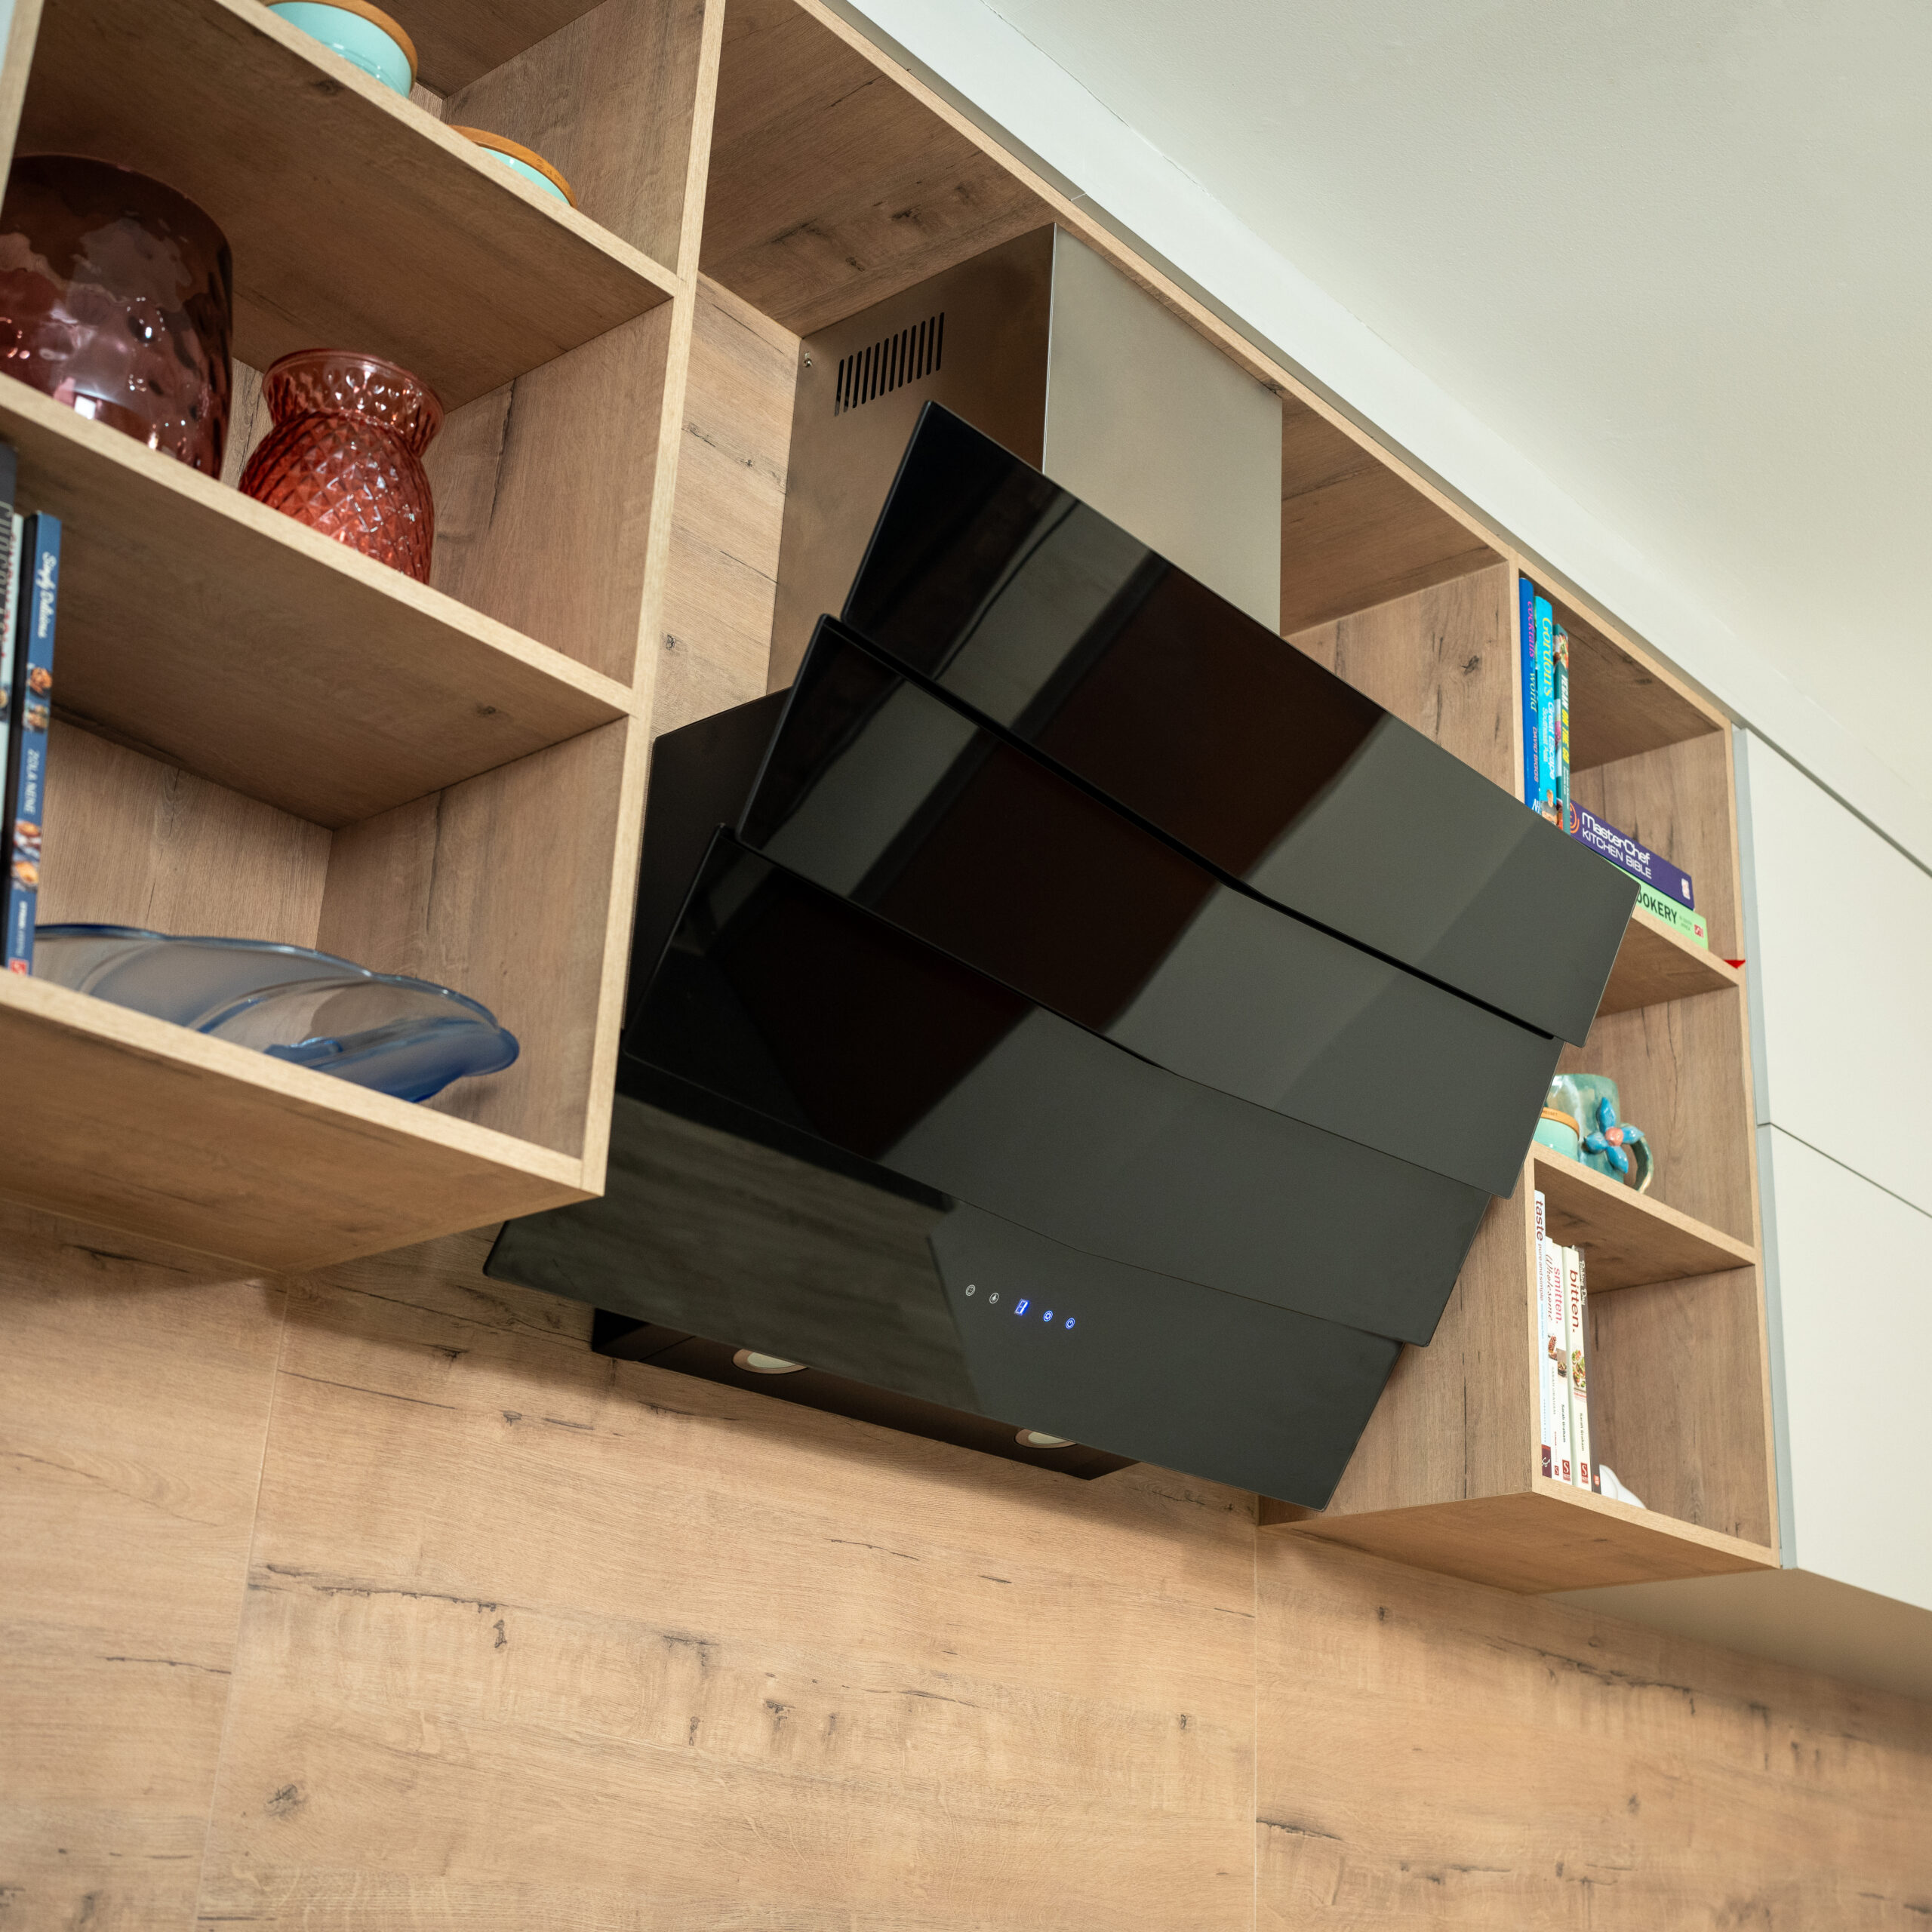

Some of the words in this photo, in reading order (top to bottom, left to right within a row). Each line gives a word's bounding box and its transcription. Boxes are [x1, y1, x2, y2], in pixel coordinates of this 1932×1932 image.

[1527, 601, 1535, 659] cocktails
[1542, 617, 1553, 697] Gordon's
[1561, 709, 1569, 727] ON
[1562, 746, 1570, 764] GO
[1582, 811, 1651, 865] MasterChef
[1582, 827, 1623, 862] KITCHEN
[1626, 855, 1652, 880] BIBLE
[1536, 1201, 1544, 1241] taste
[1546, 1254, 1554, 1321] Wholesome
[1570, 1269, 1580, 1333] bitten.
[1563, 1462, 1569, 1473] S
[1581, 1464, 1587, 1475] S
